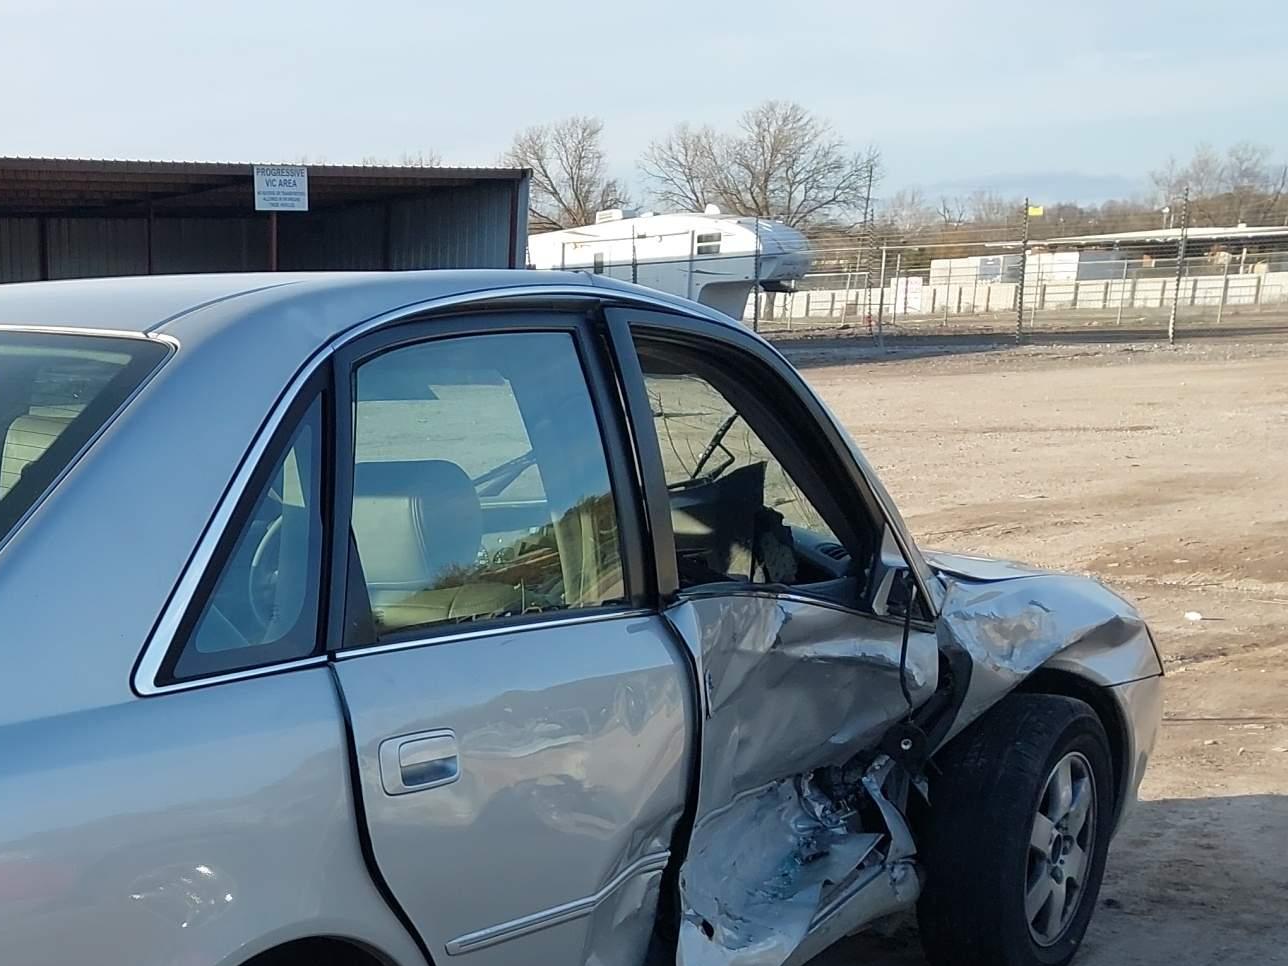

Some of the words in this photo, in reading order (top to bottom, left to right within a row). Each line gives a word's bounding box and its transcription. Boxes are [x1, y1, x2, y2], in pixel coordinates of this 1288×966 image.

[256, 168, 305, 177] PROGRESSIVE
[265, 178, 277, 188] VIC
[278, 179, 297, 188] AREA
